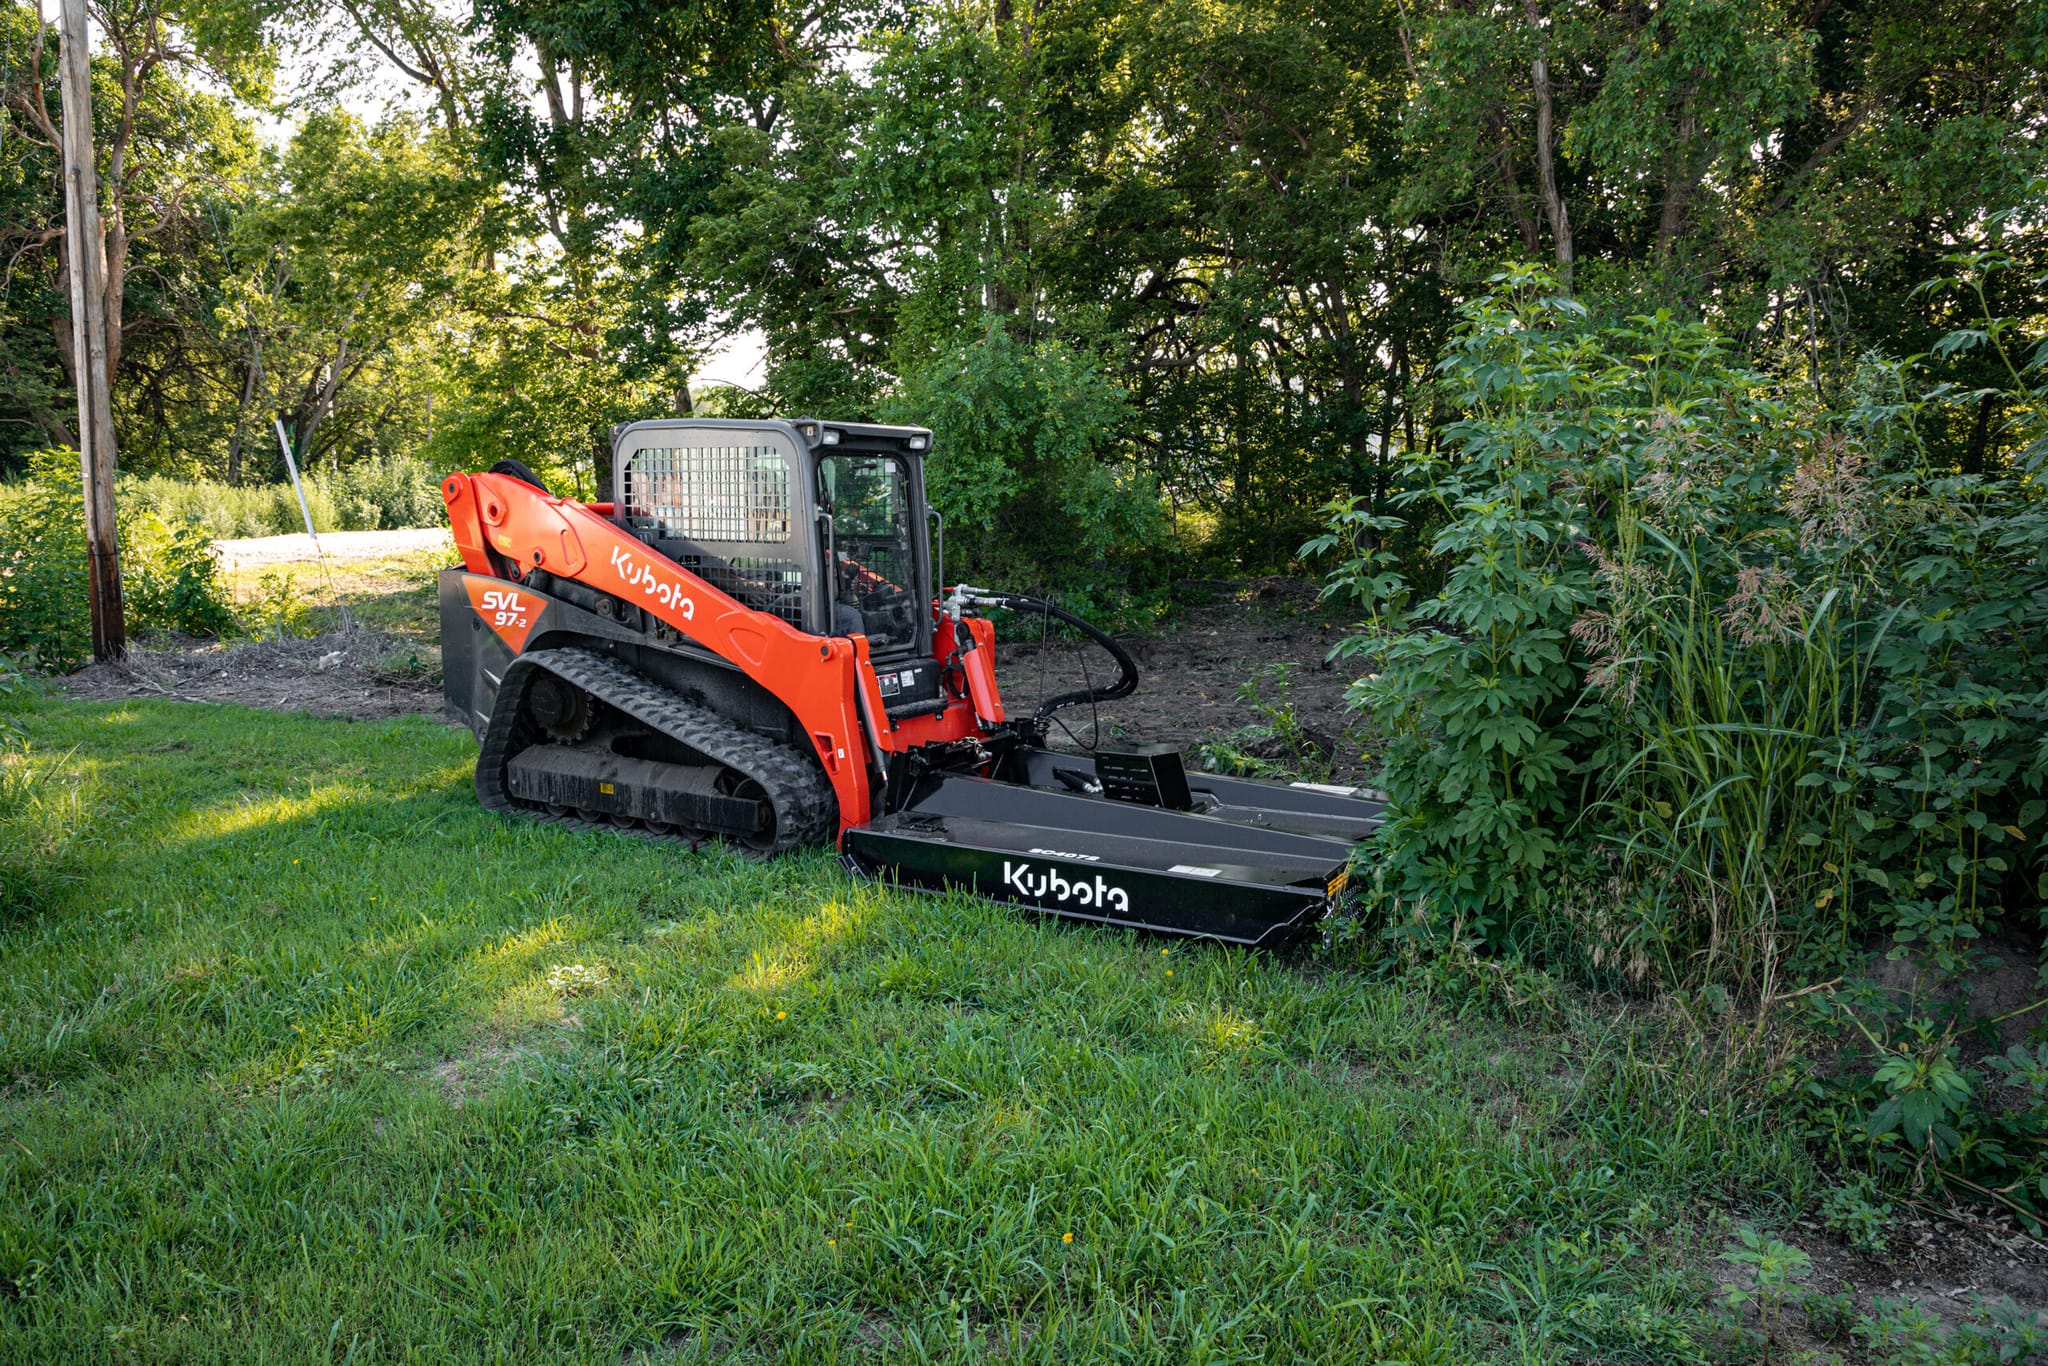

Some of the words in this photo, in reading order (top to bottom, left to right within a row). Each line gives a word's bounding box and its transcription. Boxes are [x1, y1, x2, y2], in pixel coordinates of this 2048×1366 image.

[611, 545, 695, 621] Kubota
[481, 591, 526, 612] SVL
[494, 612, 527, 628] 97-2
[1003, 861, 1129, 912] Kubota
